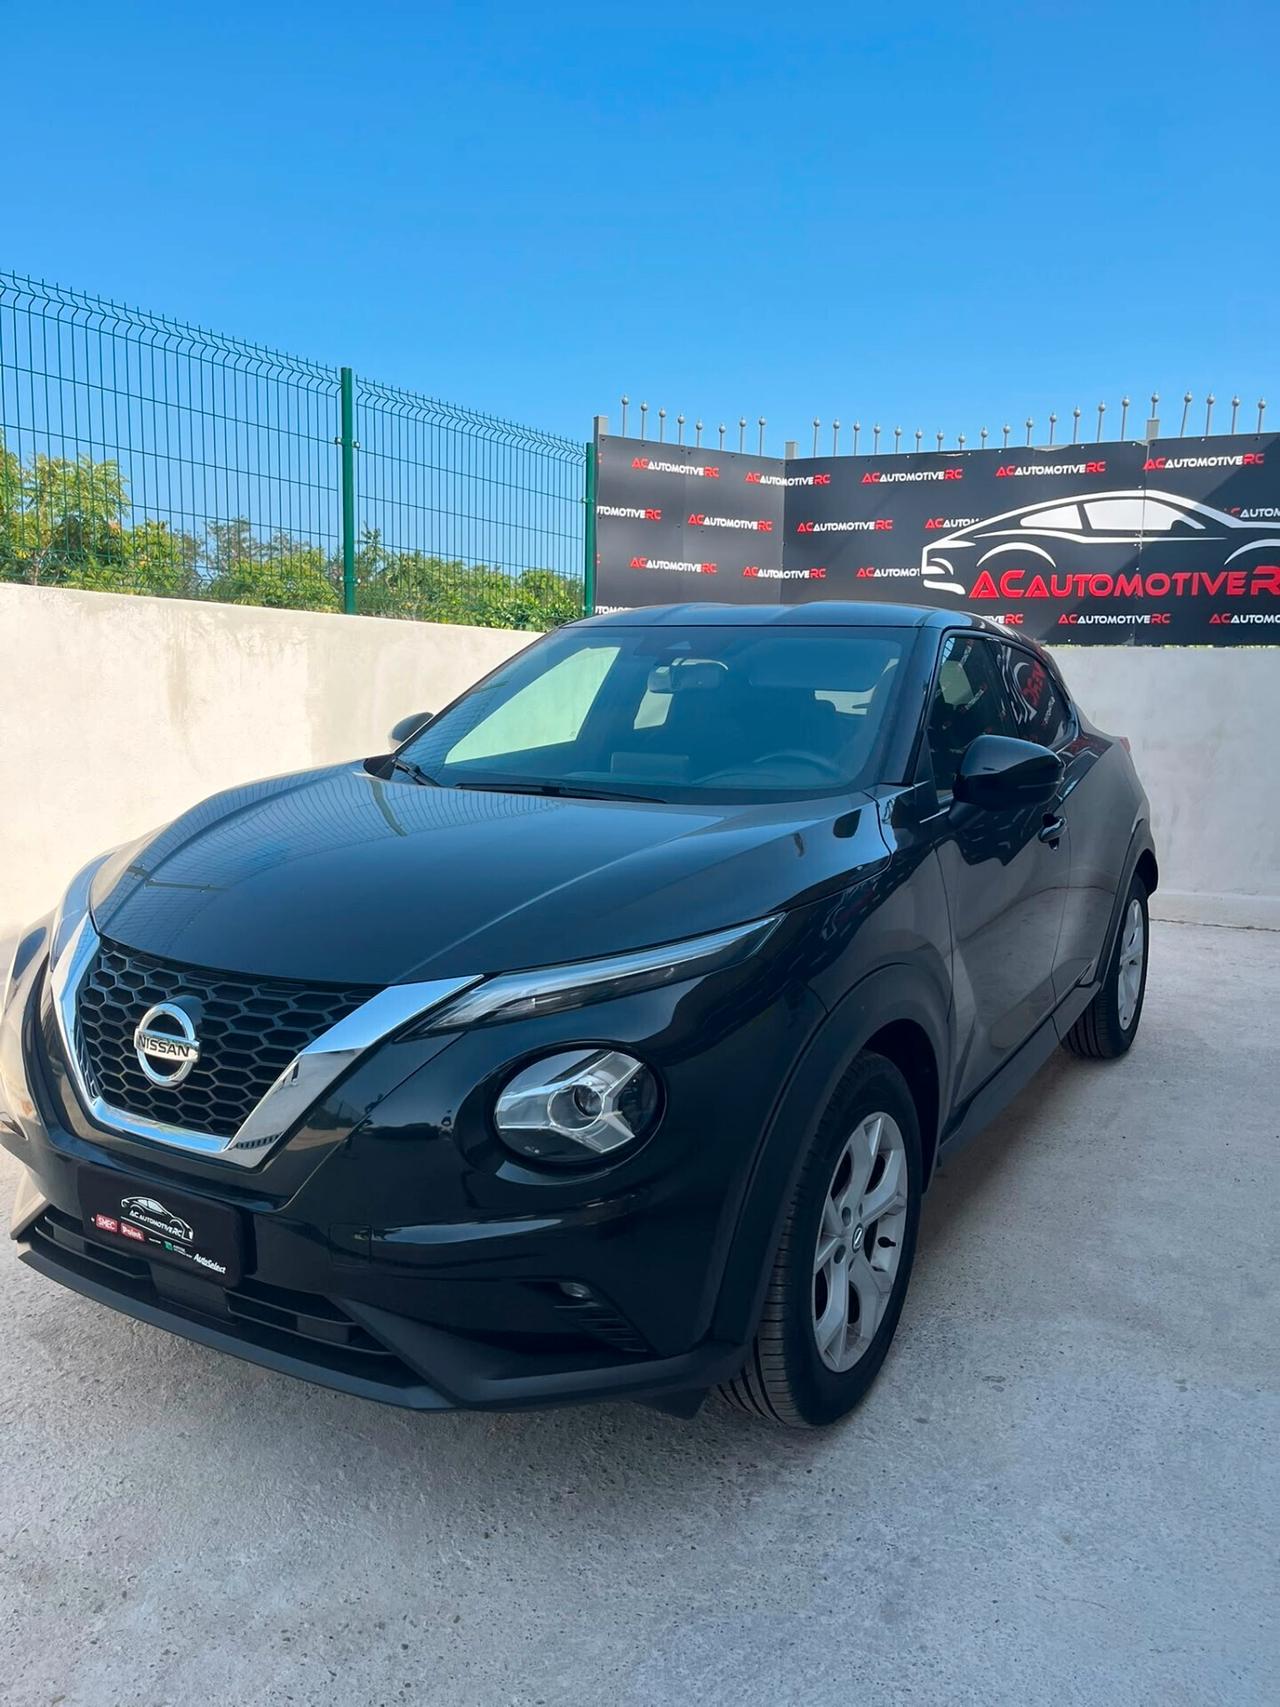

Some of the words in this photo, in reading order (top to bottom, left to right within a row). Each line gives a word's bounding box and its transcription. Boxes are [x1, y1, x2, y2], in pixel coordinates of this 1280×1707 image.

[632, 457, 720, 478] ACAUTOMOTIVERC
[995, 460, 1107, 478] ACAUTOMOTIVERC
[1143, 453, 1265, 472] ACAUTOMOTIVERC
[744, 472, 831, 486] ACAUTOMOTIVERC
[860, 469, 964, 485] ACAUTOMOTIVERC
[688, 514, 773, 532] ACAUTOMOTIVERC
[797, 518, 894, 533] ACAUTOMOTIVERC
[630, 557, 718, 574] ACAUTOMOTIVERC
[743, 566, 827, 580] ACAUTOMOTIVERC
[1058, 613, 1171, 625] ACAUTOMOTIVERC
[138, 1034, 190, 1057] NISSAN
[193, 1253, 227, 1274] AutoSelect
